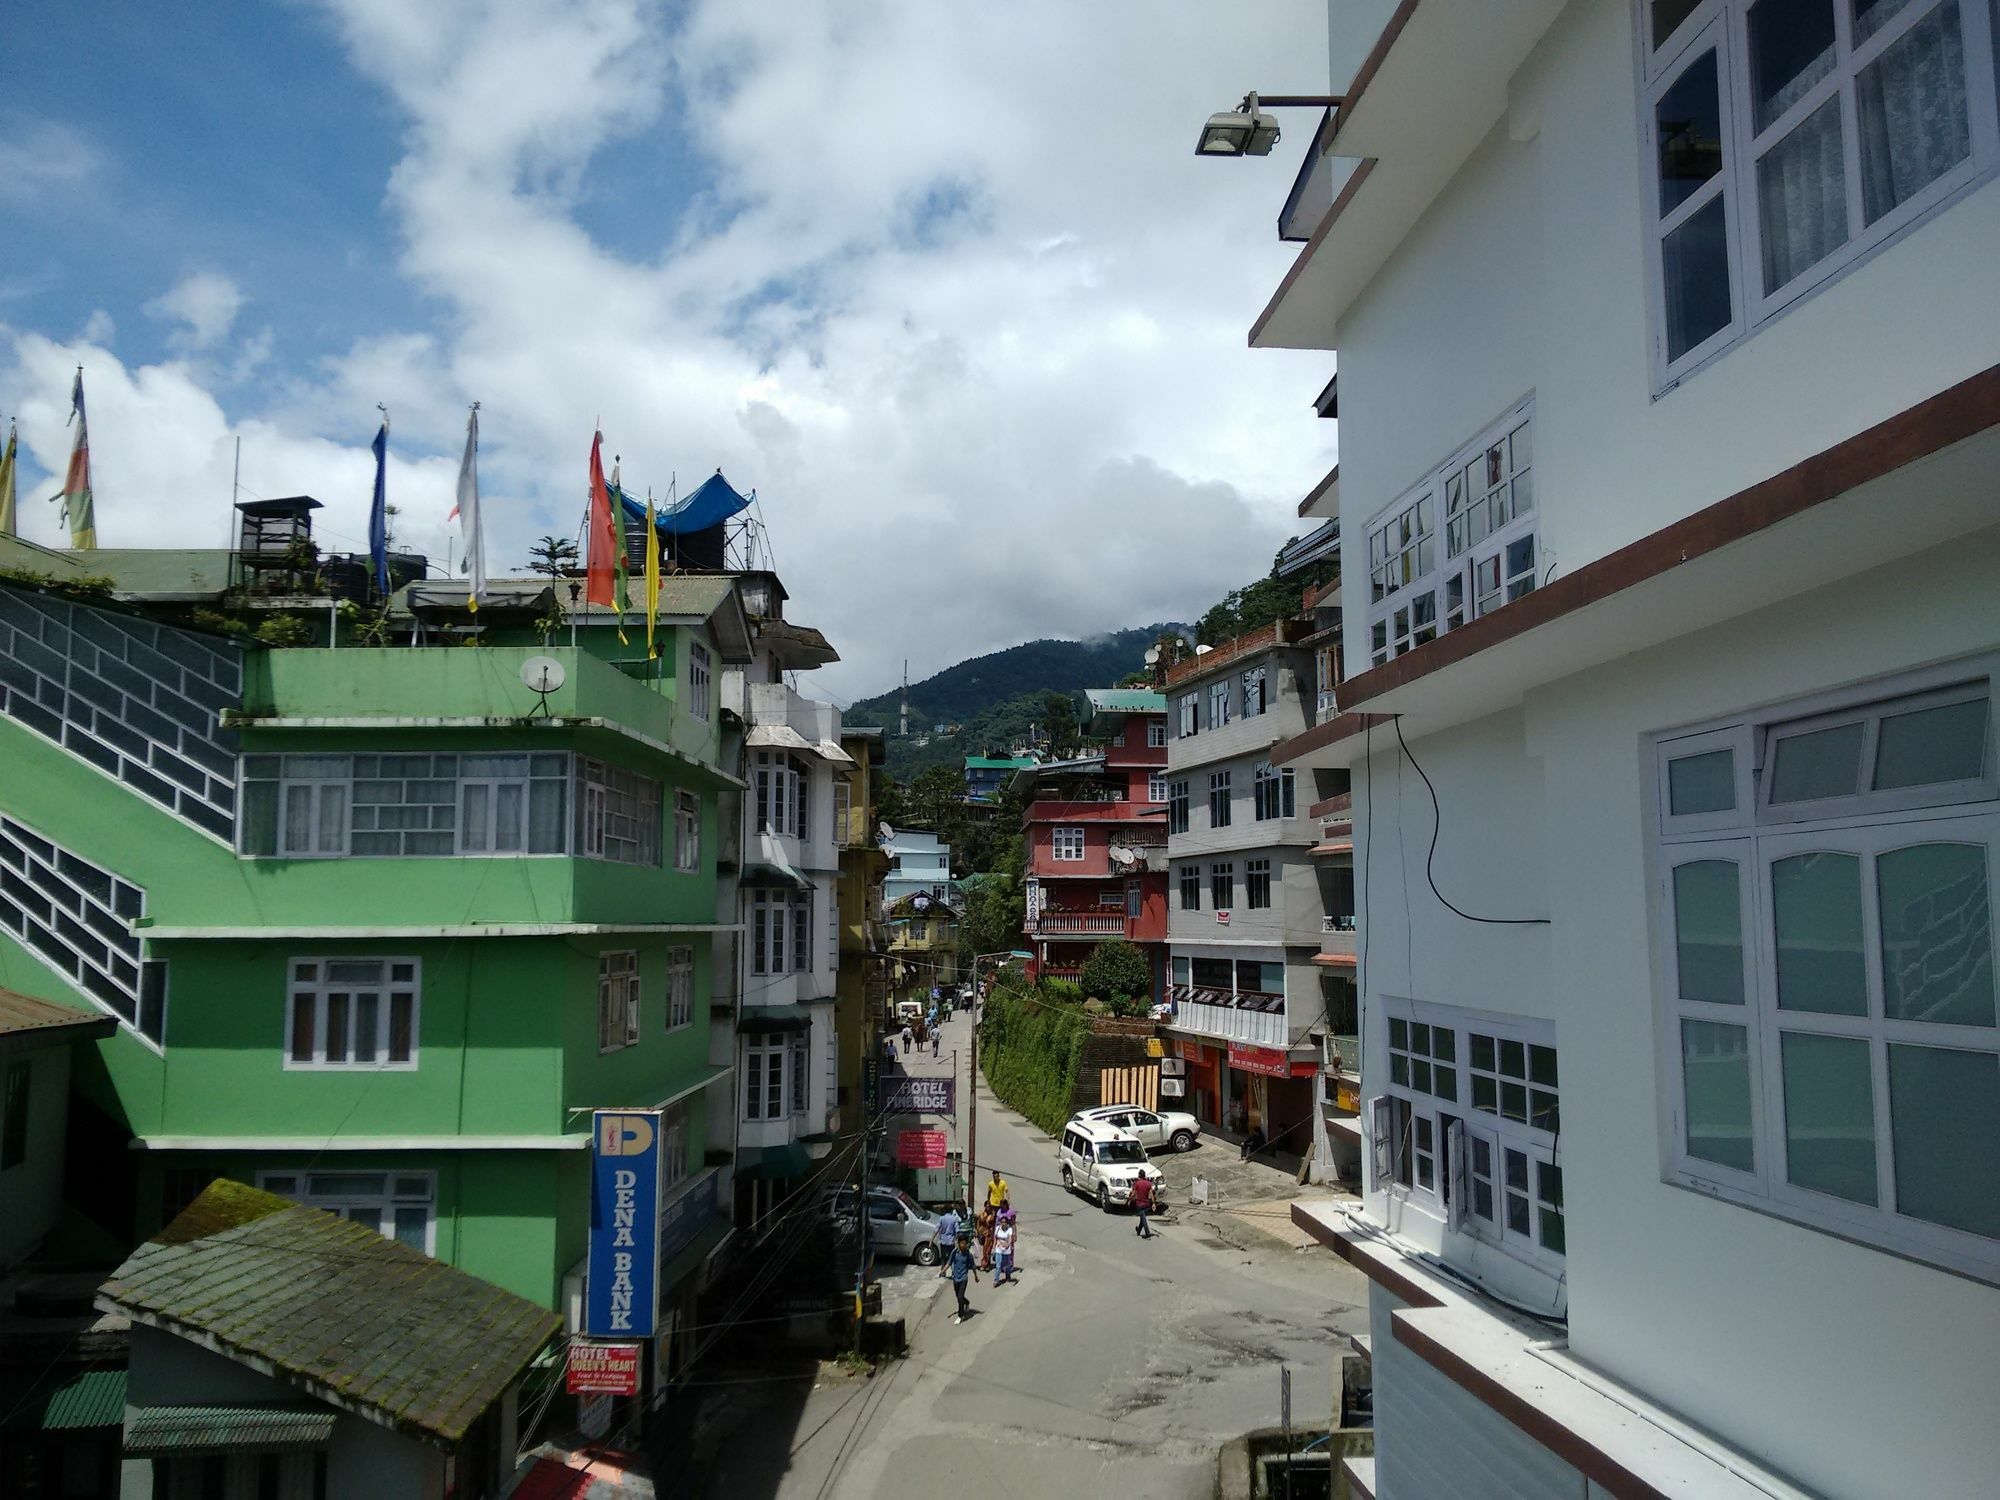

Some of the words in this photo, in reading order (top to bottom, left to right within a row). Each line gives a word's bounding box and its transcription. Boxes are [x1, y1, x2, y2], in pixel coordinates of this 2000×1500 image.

[900, 1081, 946, 1095] HOTEL
[612, 1170, 636, 1247] DENA
[610, 1252, 634, 1331] BANK
[571, 1347, 611, 1360] HOTEL
[608, 1360, 636, 1372] HEART
